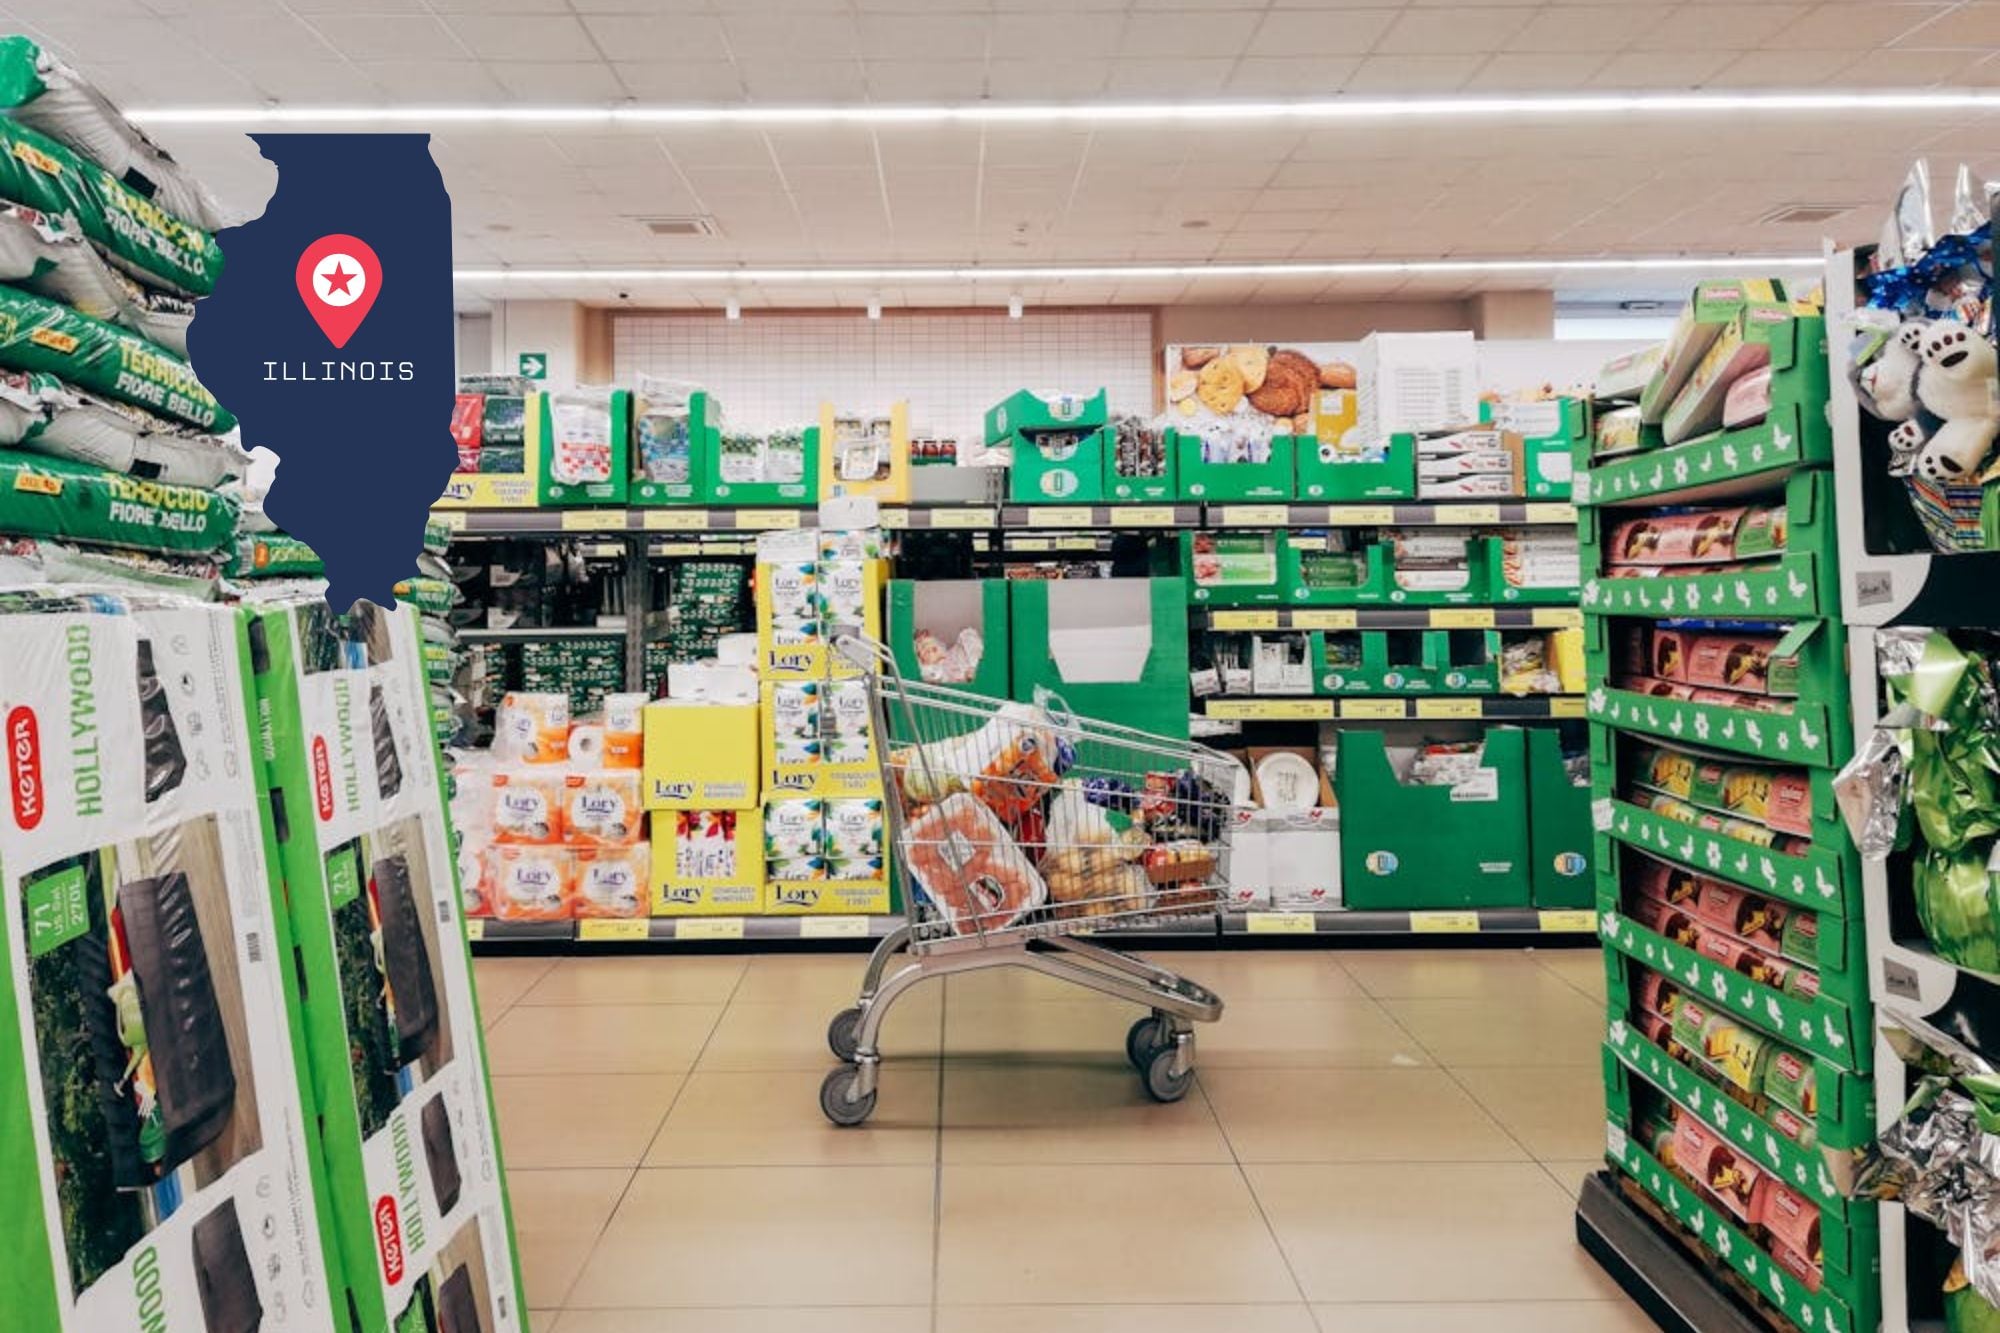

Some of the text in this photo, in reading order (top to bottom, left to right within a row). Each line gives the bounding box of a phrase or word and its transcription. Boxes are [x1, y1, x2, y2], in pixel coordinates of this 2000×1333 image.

[115, 370, 215, 428] FIORE BELLO
[109, 501, 155, 526] FIORE
[768, 650, 812, 672] Lory
[66, 624, 104, 817] HOLLYWOOD
[655, 779, 695, 800] Lory
[773, 770, 816, 791] Lory
[663, 884, 704, 905] Lory
[776, 884, 820, 908] Lory
[34, 902, 53, 937] 71
